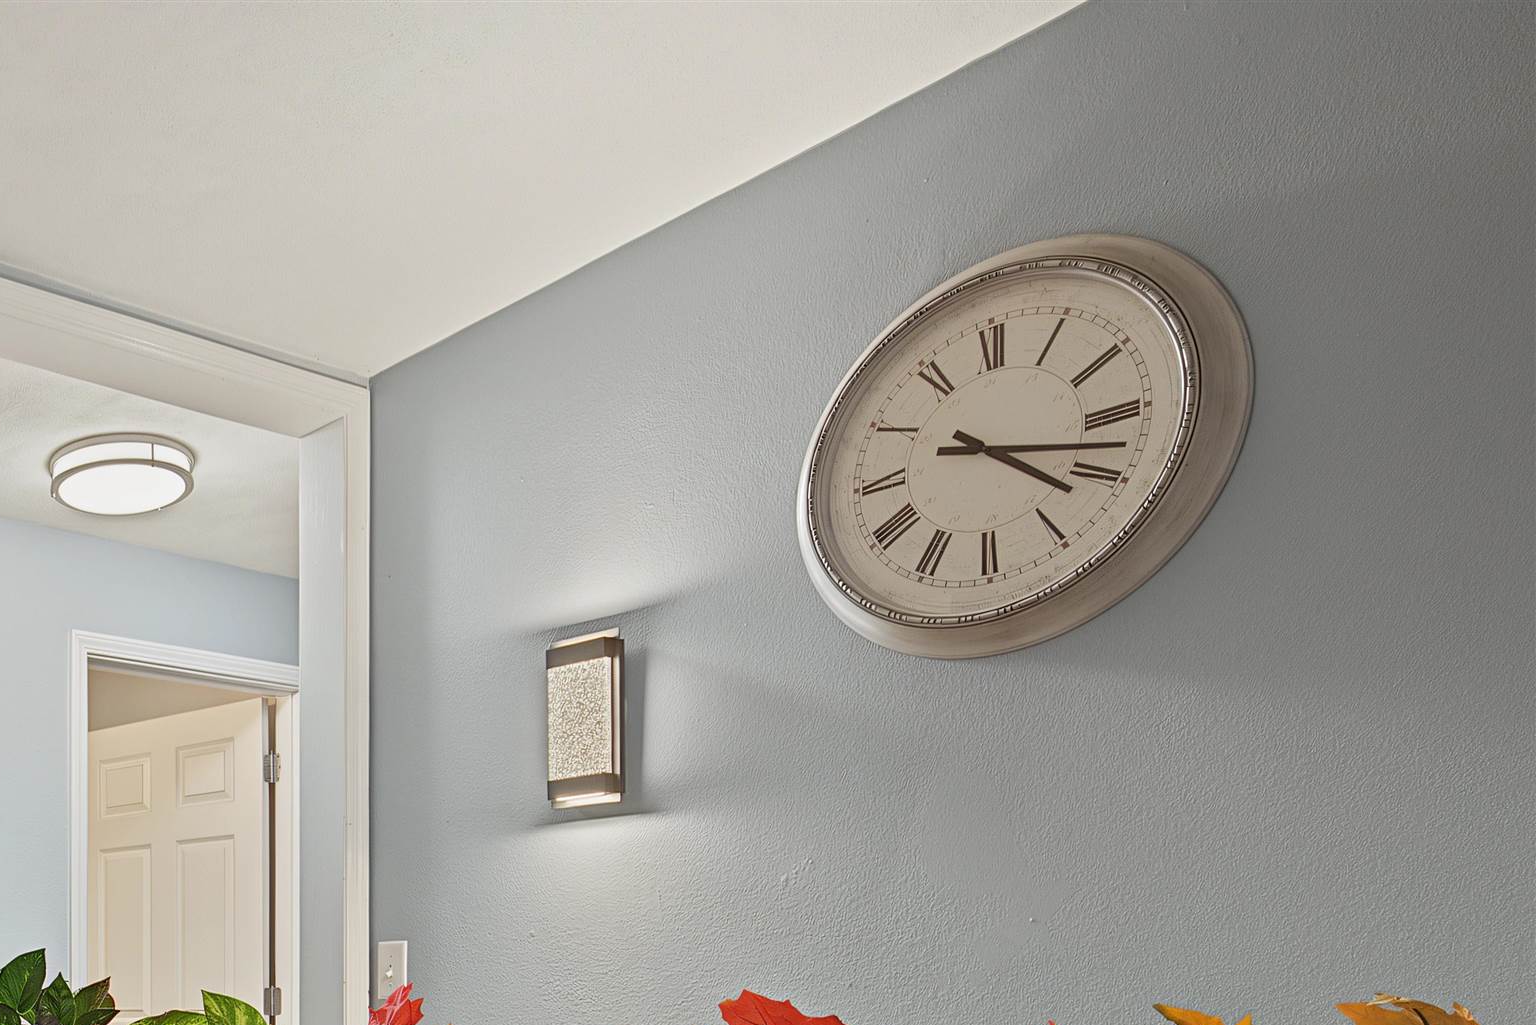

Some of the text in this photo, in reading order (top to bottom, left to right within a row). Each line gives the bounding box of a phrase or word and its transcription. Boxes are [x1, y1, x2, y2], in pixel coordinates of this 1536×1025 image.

[977, 323, 1005, 375] XII
[1035, 318, 1066, 366] I
[917, 360, 956, 402] XI
[1070, 343, 1123, 389] II
[876, 420, 919, 441] X
[1084, 397, 1140, 432] III
[862, 467, 906, 496] IX
[1069, 461, 1124, 488] IV
[871, 502, 921, 551] VIII
[1035, 507, 1066, 546] V
[915, 529, 953, 577] VII
[981, 530, 999, 576] VI
